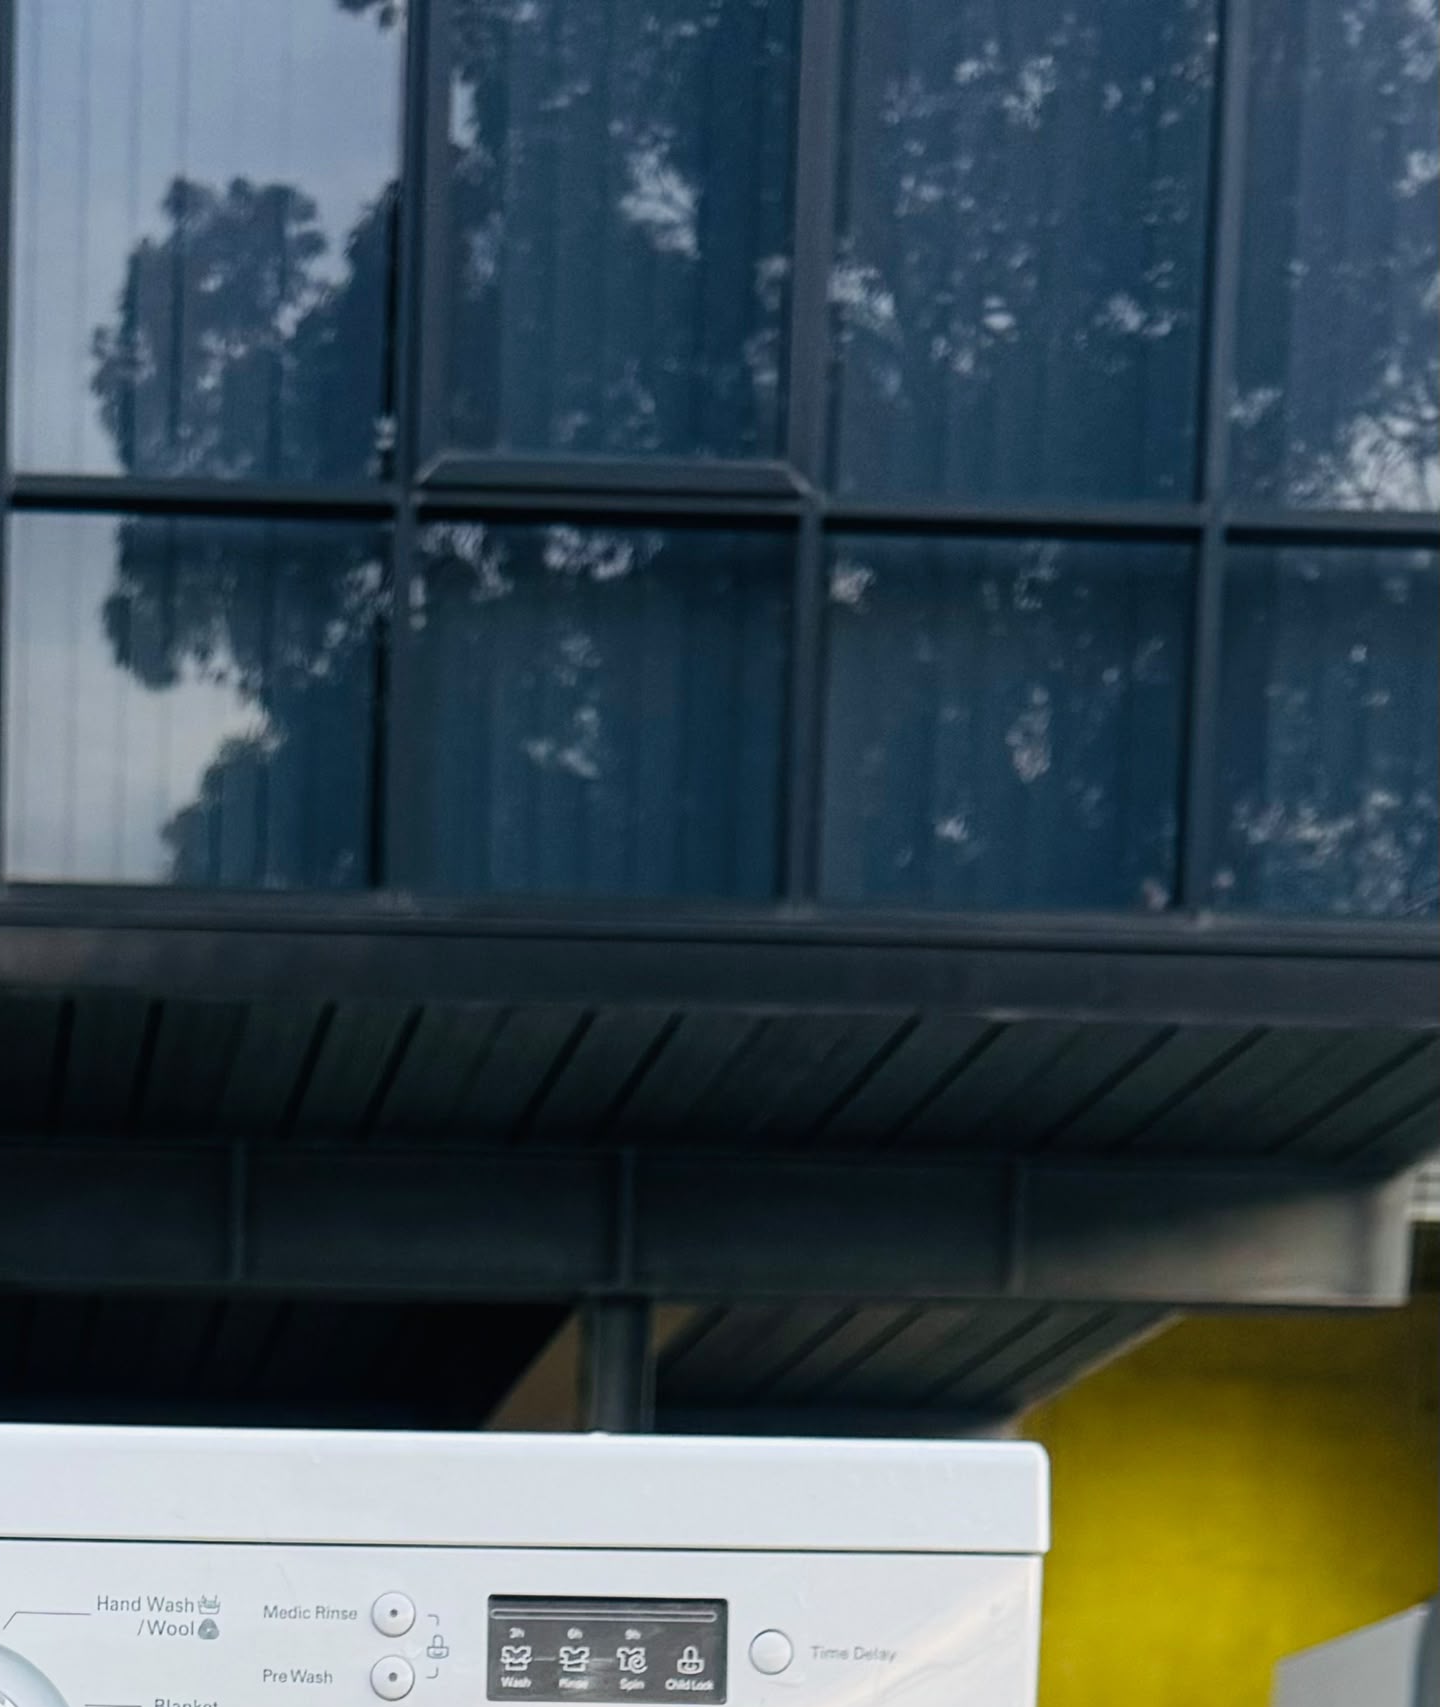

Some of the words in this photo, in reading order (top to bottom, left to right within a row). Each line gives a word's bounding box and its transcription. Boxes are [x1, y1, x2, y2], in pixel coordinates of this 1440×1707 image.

[97, 1595, 141, 1612] Hand
[147, 1596, 194, 1613] Wash
[263, 1605, 311, 1620] Medic
[315, 1605, 358, 1620] Rinse
[810, 1645, 849, 1660] Time
[853, 1646, 897, 1663] Delay
[263, 1668, 288, 1683] Pre
[290, 1669, 333, 1684] Wash
[501, 1676, 532, 1688] Wash
[619, 1678, 645, 1691] Spin
